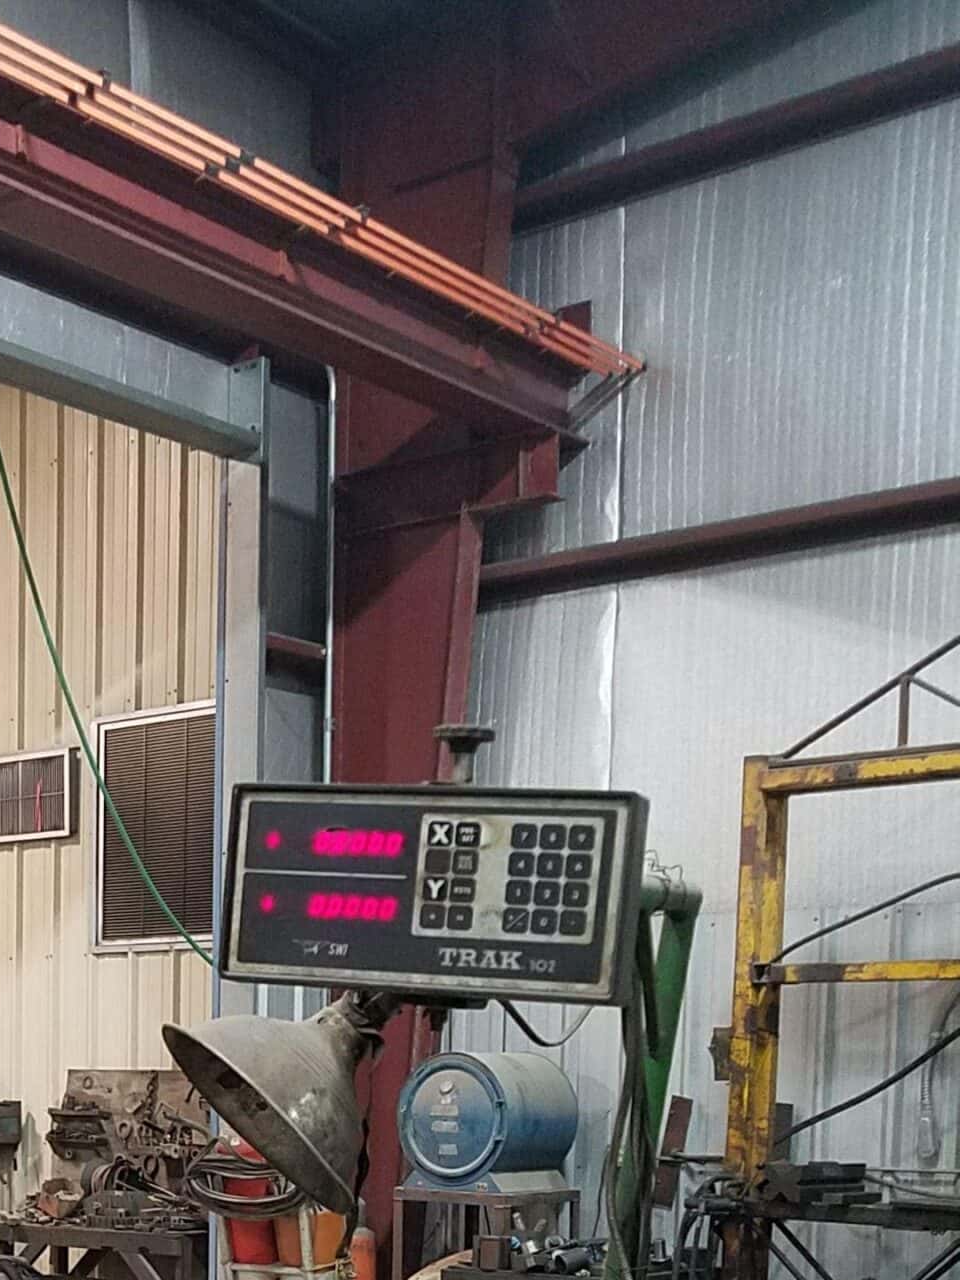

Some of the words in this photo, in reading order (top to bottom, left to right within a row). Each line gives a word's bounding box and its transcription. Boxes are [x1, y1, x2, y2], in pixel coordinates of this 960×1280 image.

[431, 824, 449, 844] X
[427, 879, 444, 900] Y
[438, 947, 523, 971] TRAK
